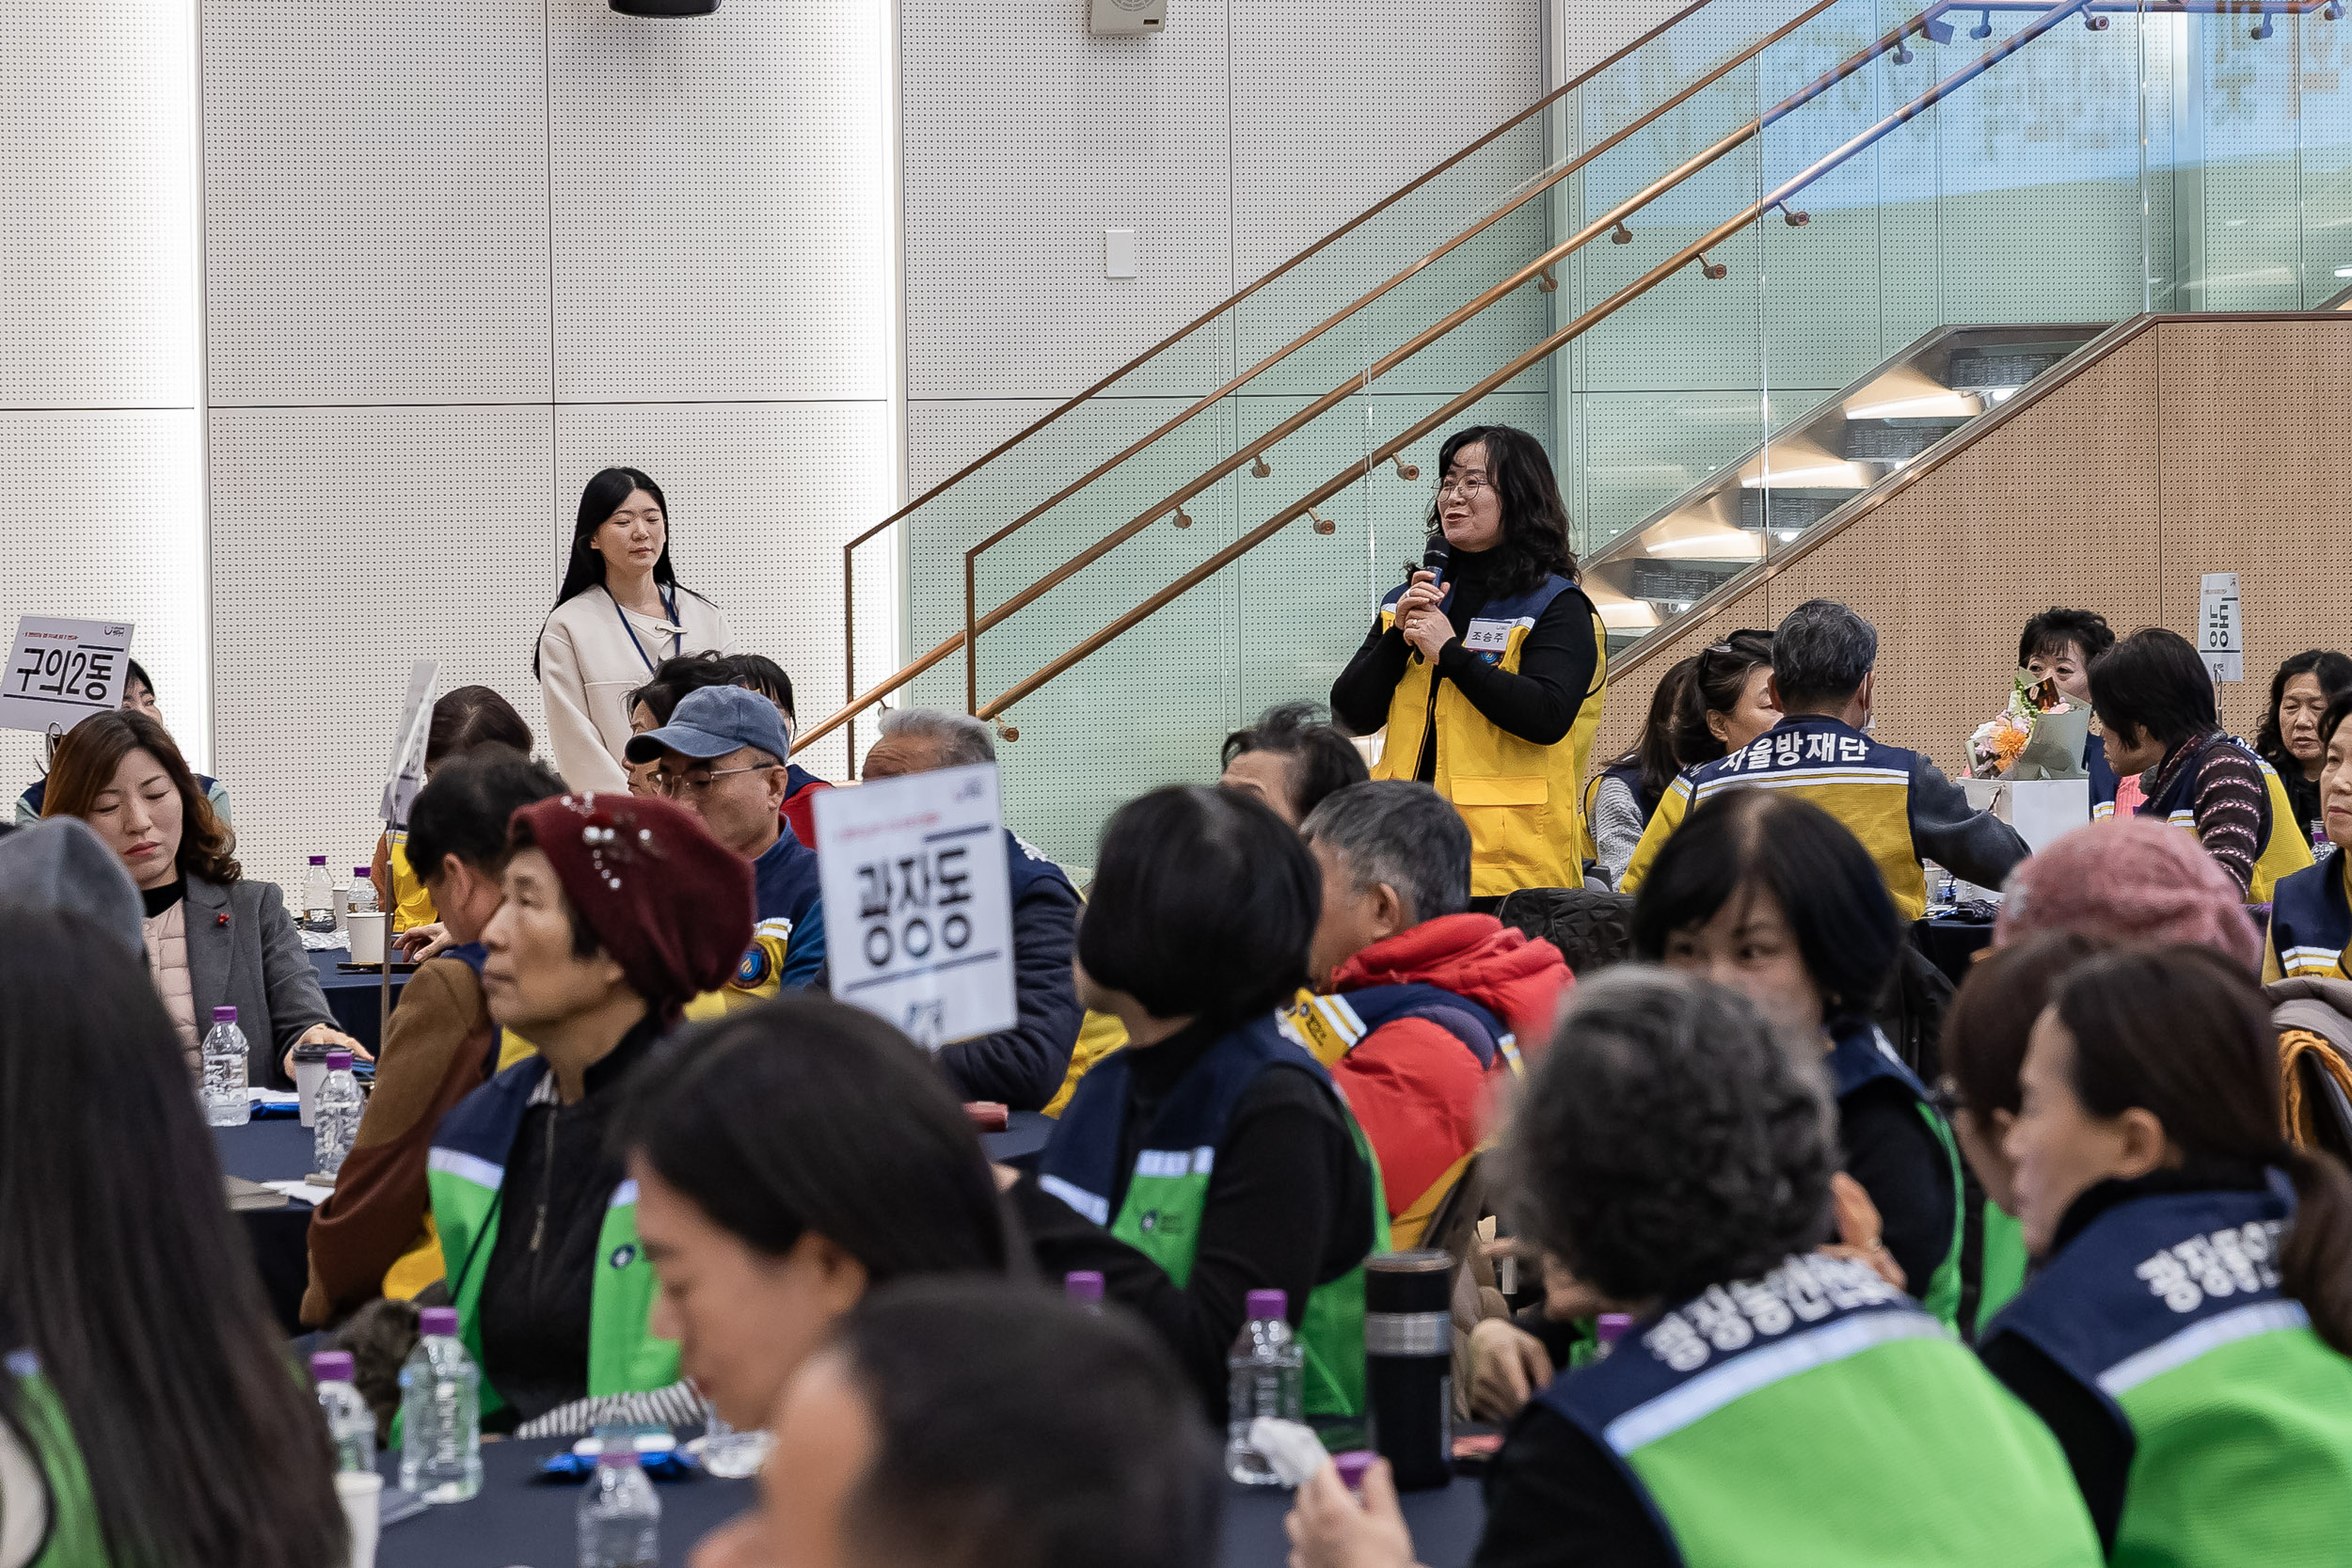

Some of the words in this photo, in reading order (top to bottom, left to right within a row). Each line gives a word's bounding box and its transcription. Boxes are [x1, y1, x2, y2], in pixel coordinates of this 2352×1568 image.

[1471, 631, 1503, 642] 조승주
[2209, 605, 2229, 647] 능동
[17, 647, 114, 701] 구의2동
[857, 847, 971, 966] 광장동
